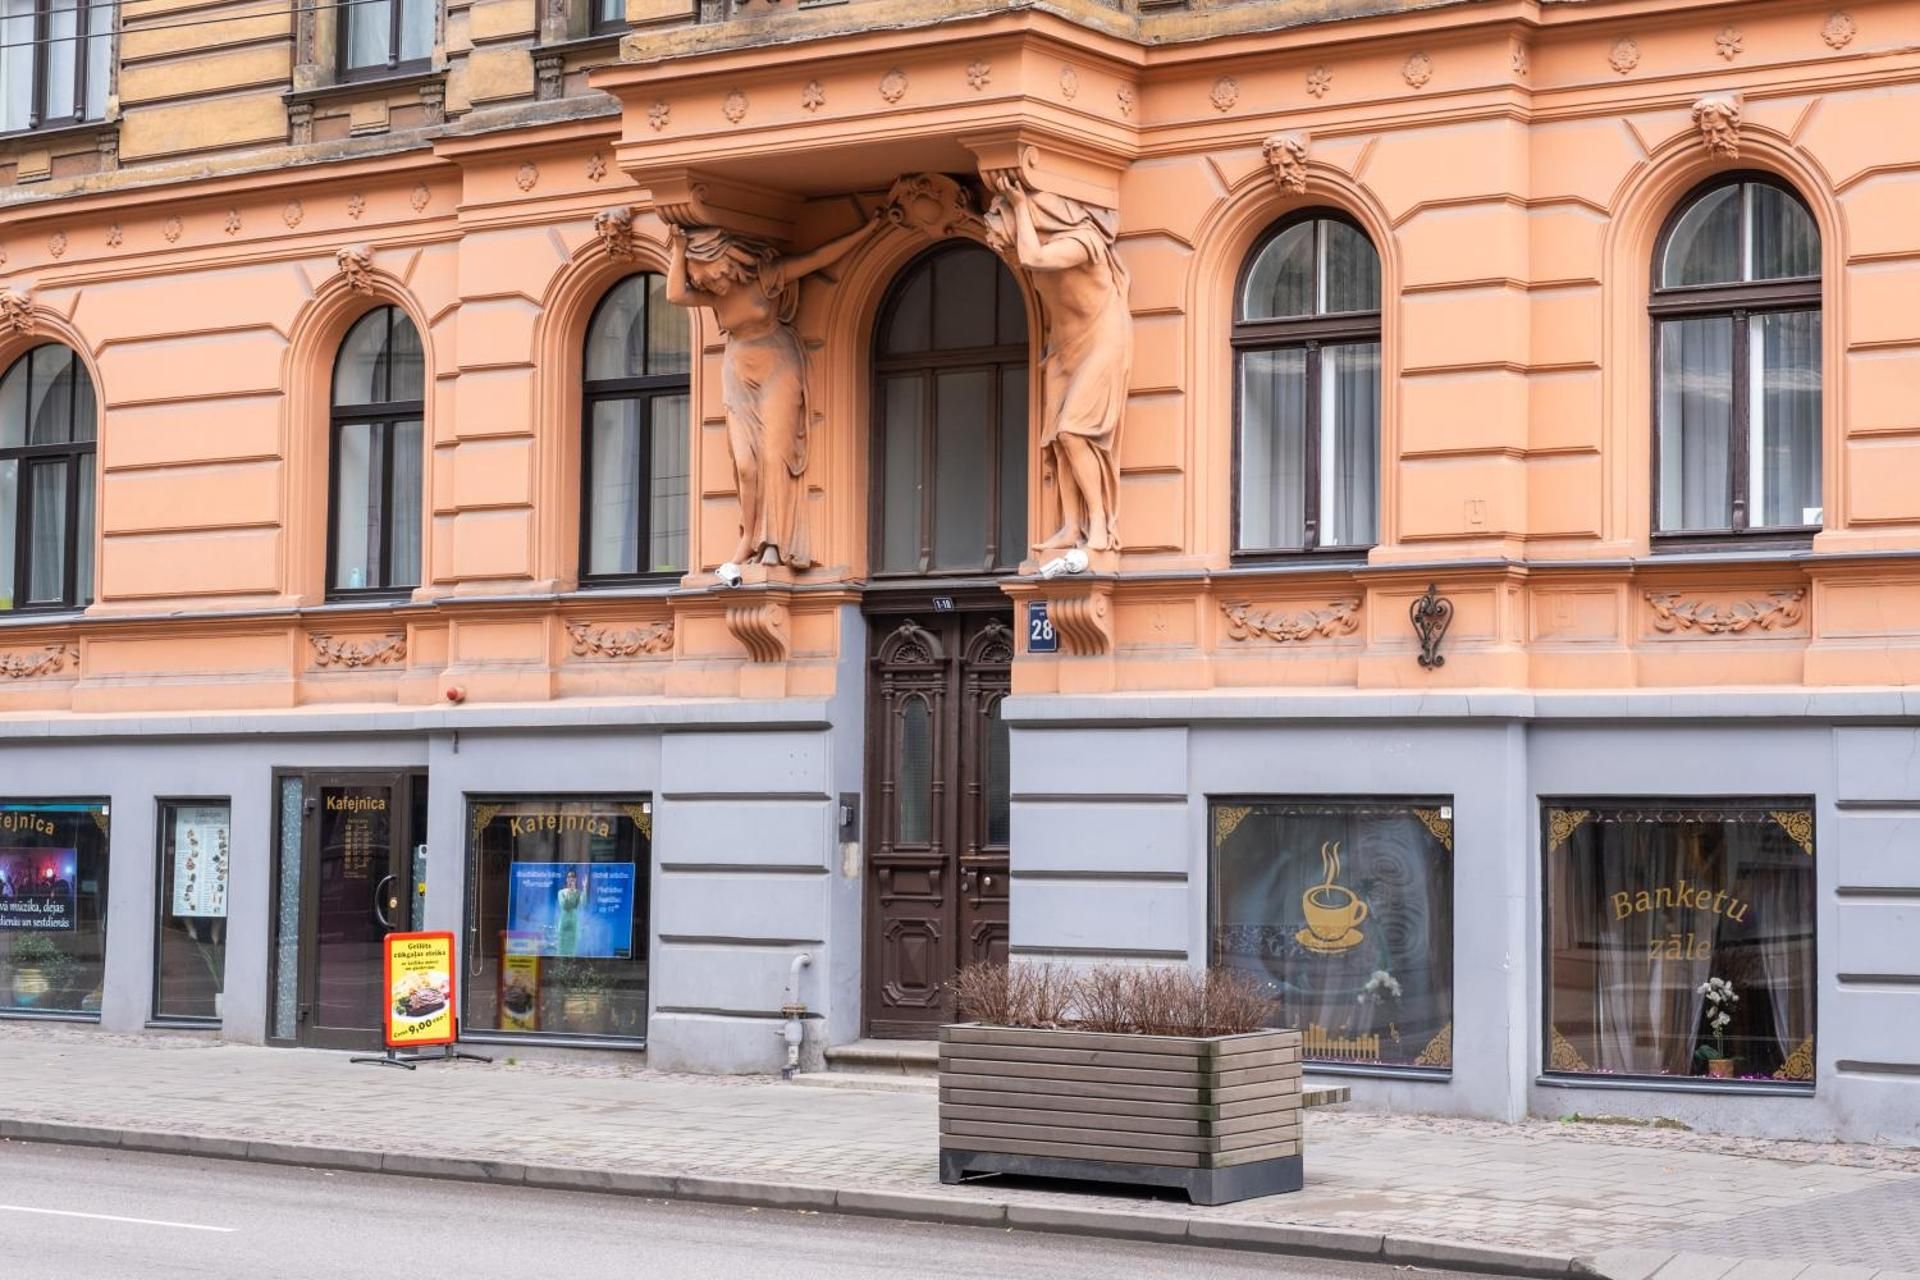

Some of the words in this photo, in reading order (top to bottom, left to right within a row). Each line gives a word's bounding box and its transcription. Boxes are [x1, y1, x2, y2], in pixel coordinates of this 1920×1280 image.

[1031, 619, 1053, 640] 28
[326, 796, 386, 813] Kafejnīca
[0, 812, 55, 836] ejnīca
[510, 813, 610, 837] Kafejnīca
[43, 899, 65, 916] dejas
[1611, 880, 1748, 923] Banketu
[1650, 933, 1711, 961] zāle
[408, 1019, 432, 1035] 9,00
